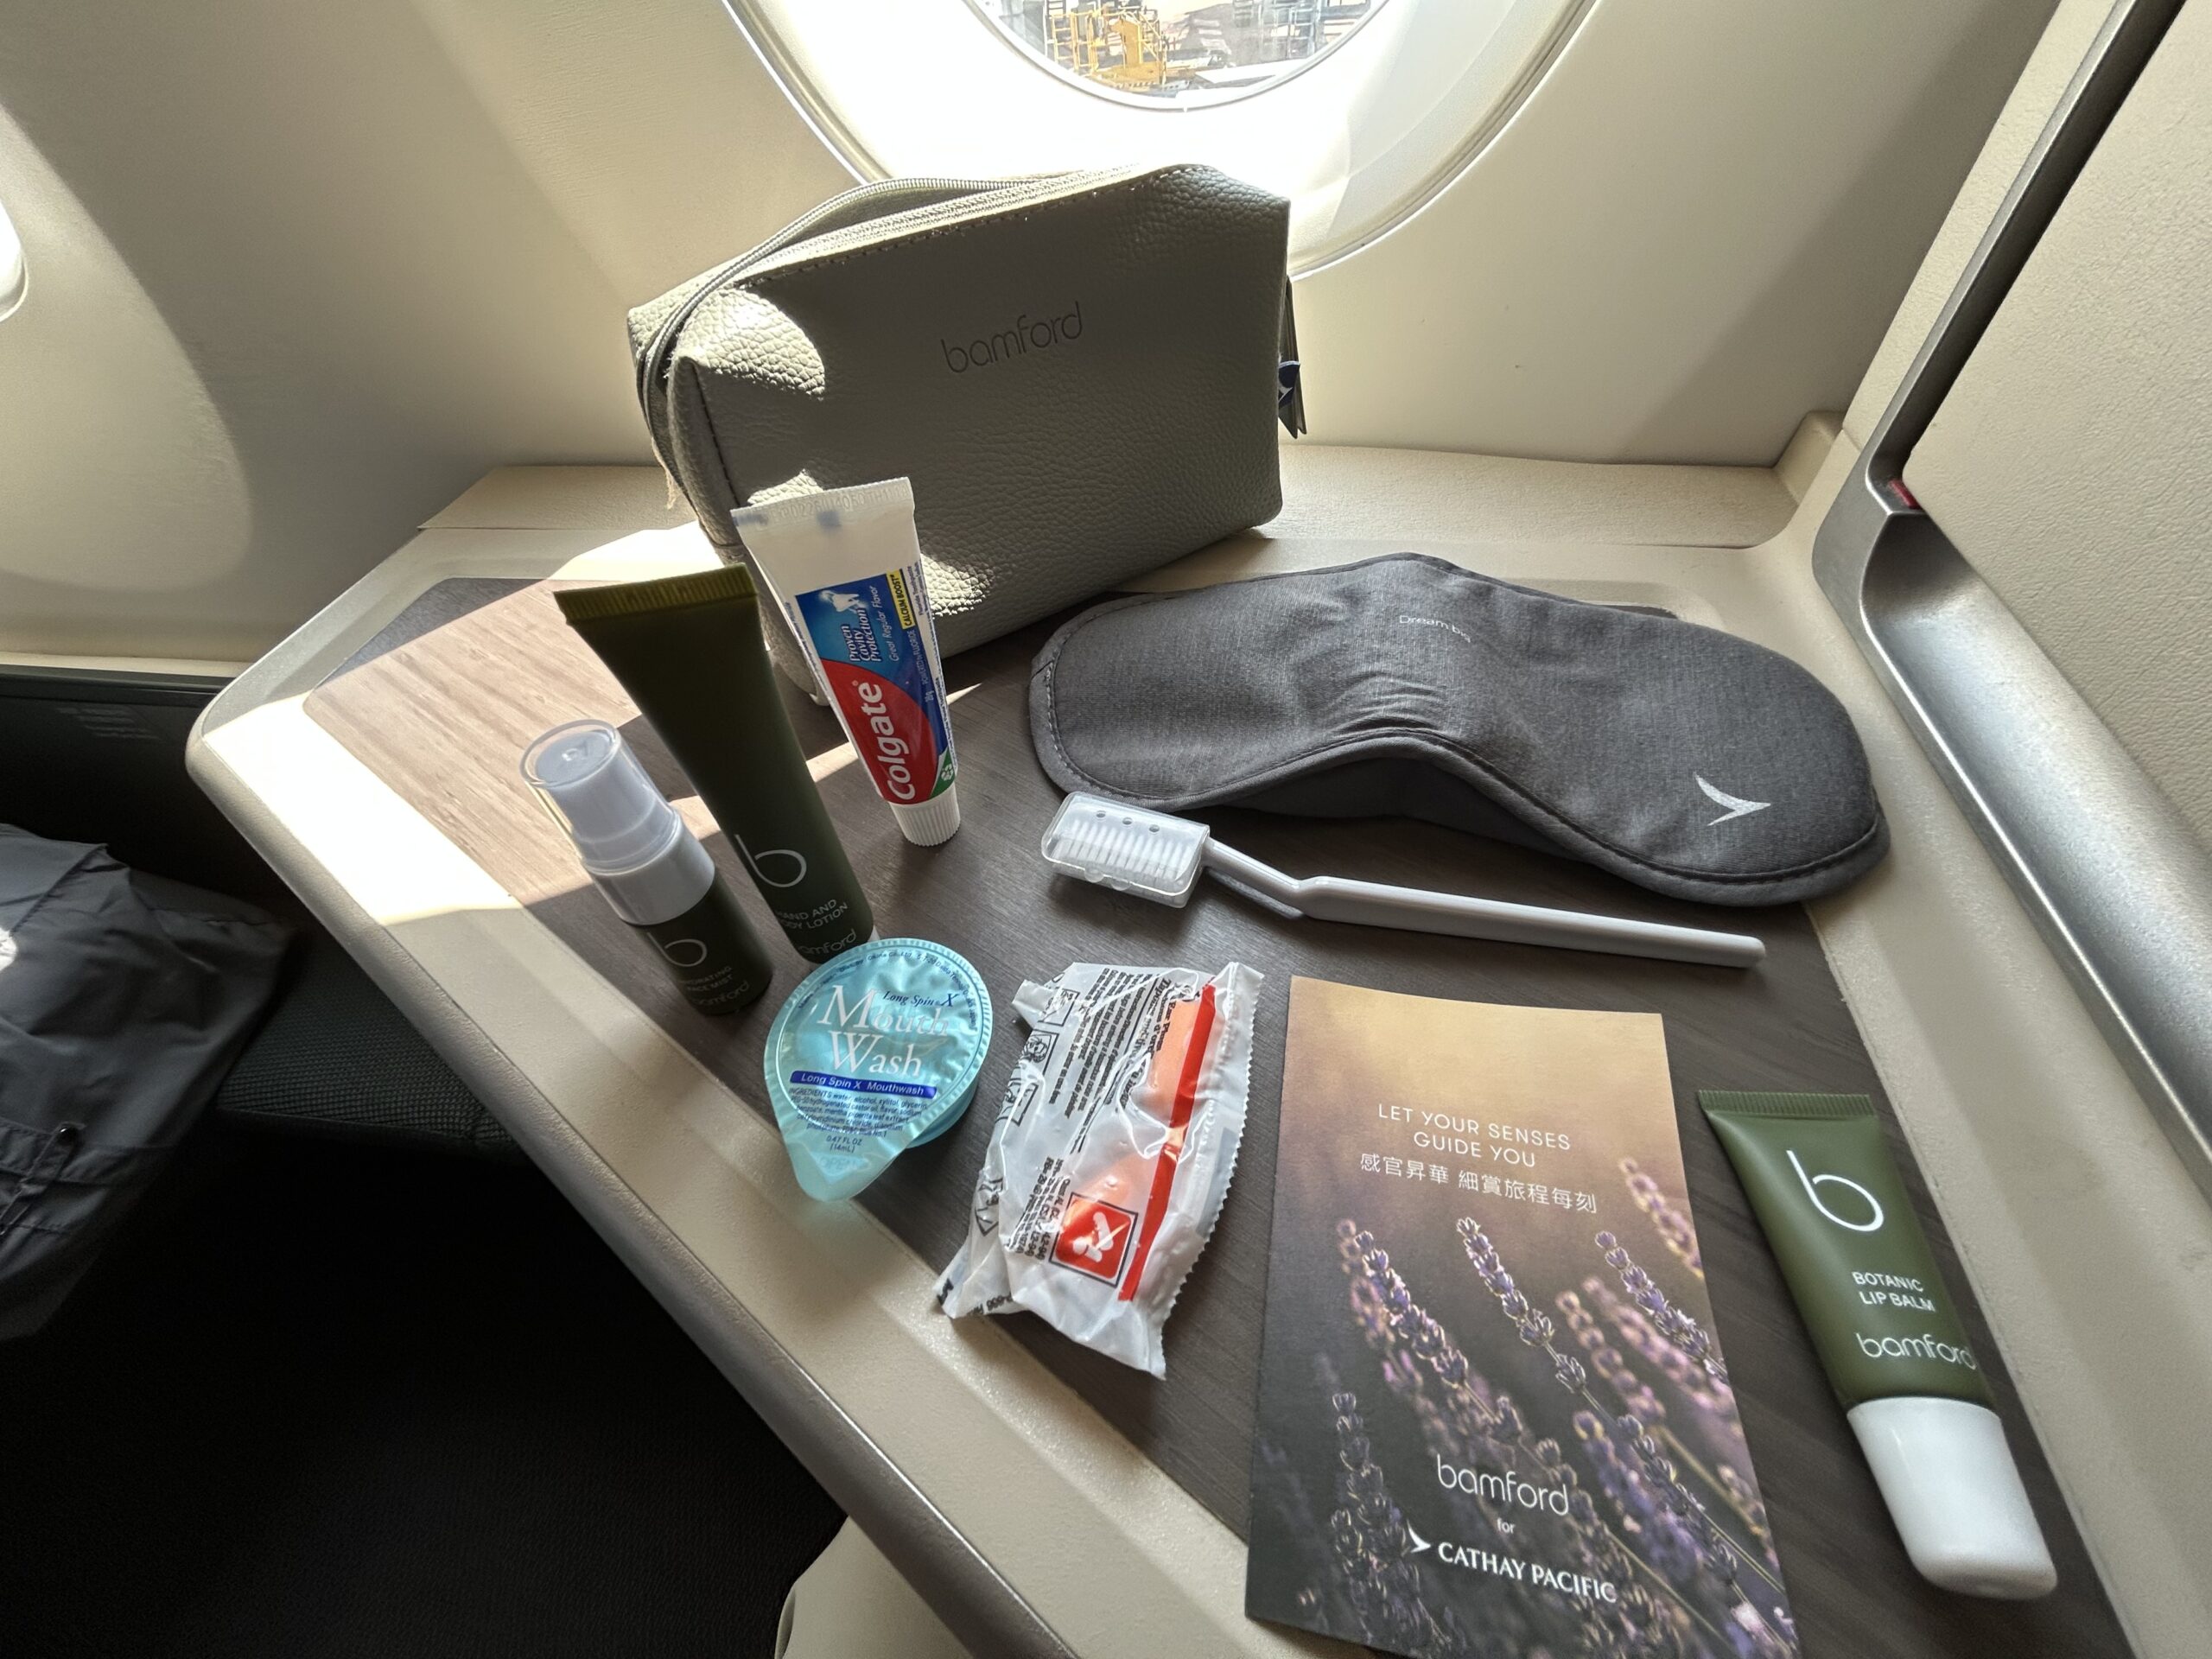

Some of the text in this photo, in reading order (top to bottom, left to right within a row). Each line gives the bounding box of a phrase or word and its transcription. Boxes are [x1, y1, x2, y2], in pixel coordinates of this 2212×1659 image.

[940, 301, 1083, 373] bamford
[868, 584, 899, 662] Great Regular Flavor
[898, 598, 913, 626] CALCIUM
[1400, 614, 1449, 630] Dream
[840, 624, 861, 662] Proven
[852, 626, 872, 662] Cavity
[854, 605, 882, 663] Protection
[906, 628, 921, 655] FLUORIDE
[859, 682, 916, 801] Colgate
[735, 834, 807, 887] b
[808, 902, 849, 929] LOTION
[812, 899, 837, 916] AND
[647, 931, 707, 968] b
[817, 984, 949, 1037] Mouth
[882, 990, 958, 1008] Long Spin X
[828, 1030, 923, 1080] Wash
[801, 1073, 925, 1096] Long Spin X Mouthwash
[1378, 1103, 1571, 1150] LET YOUR SENSES
[1414, 1132, 1535, 1167] GUIDE YOU
[1786, 1150, 1885, 1231] b
[1852, 1272, 1924, 1293] BOTANIC
[1859, 1292, 1936, 1312] LIP BALM
[1437, 1452, 1569, 1516] bamford
[1497, 1517, 1516, 1535] for
[1438, 1541, 1617, 1603] CATHAY PACIFIC
